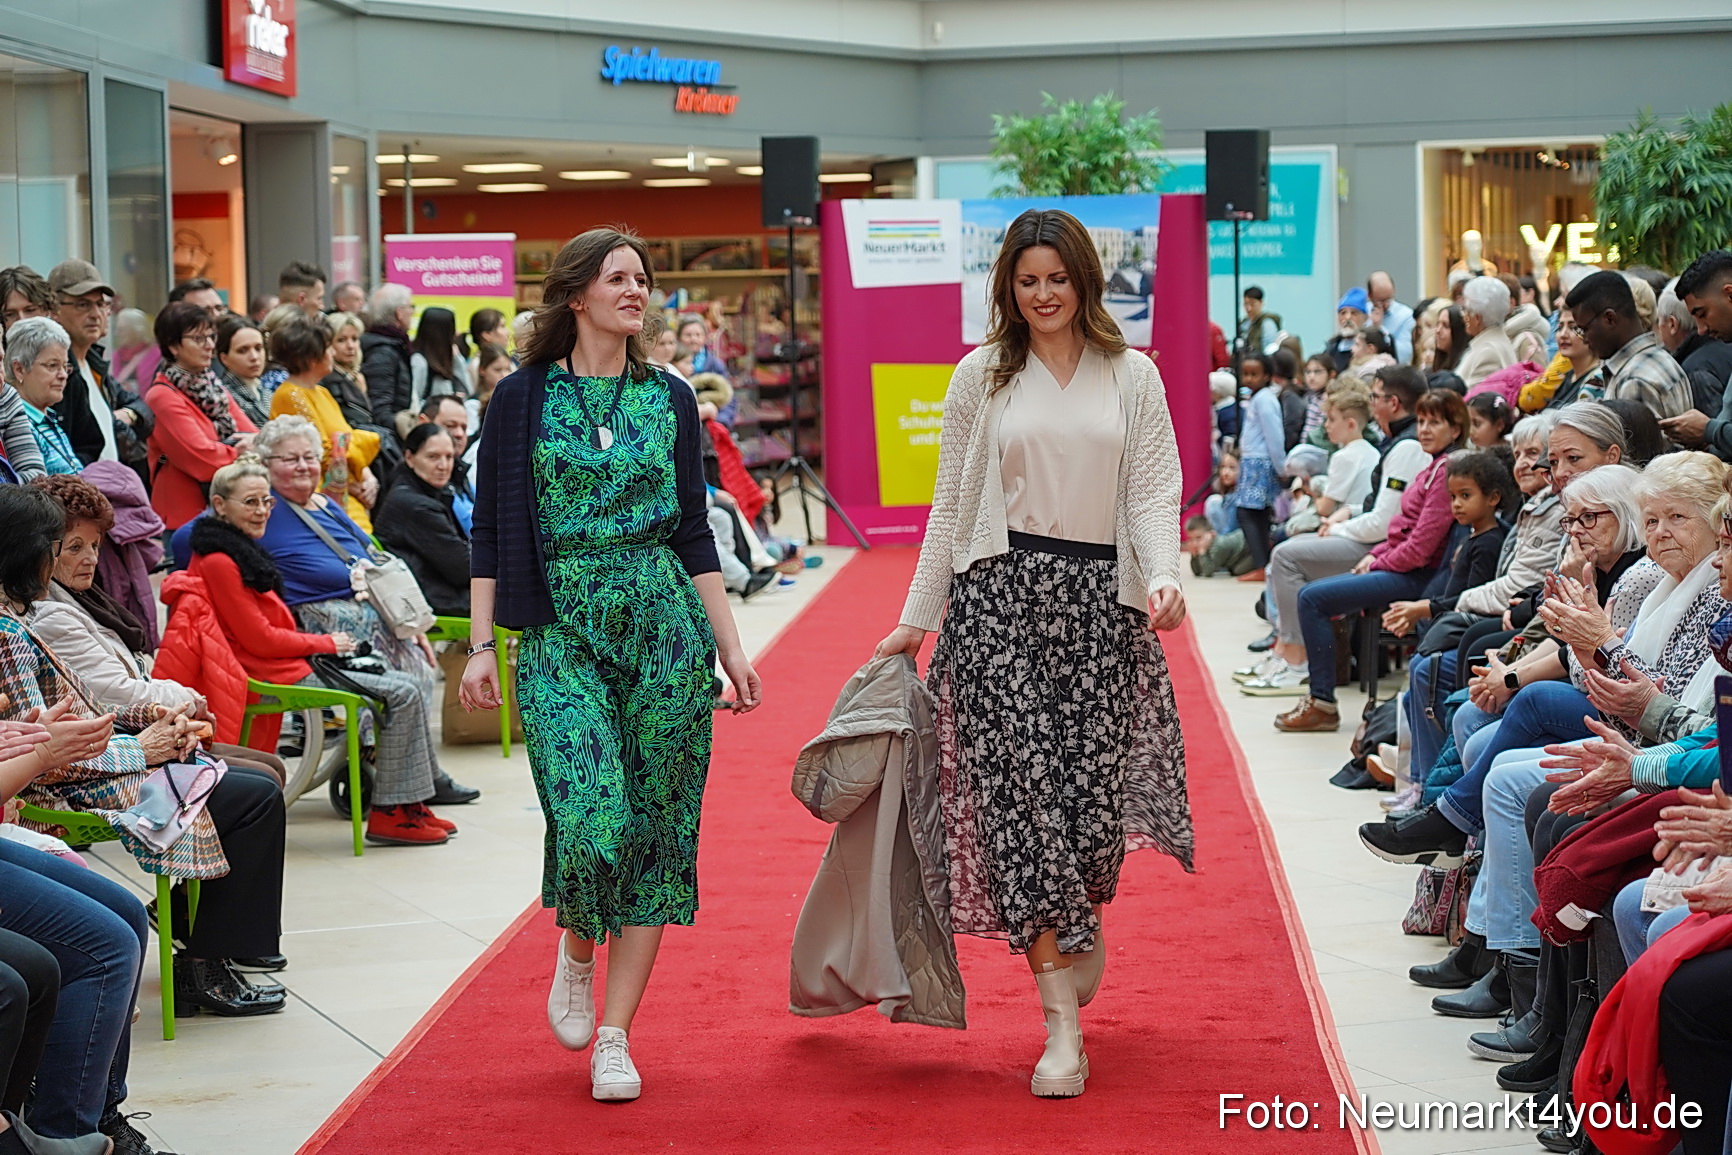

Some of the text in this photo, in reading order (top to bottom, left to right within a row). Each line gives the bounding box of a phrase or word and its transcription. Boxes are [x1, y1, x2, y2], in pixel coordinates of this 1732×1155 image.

[601, 45, 722, 85] Spielwaren
[394, 255, 502, 272] Verschenken Sie
[422, 271, 503, 287] Gutscheine!
[911, 399, 929, 413] Du
[909, 431, 935, 445] und
